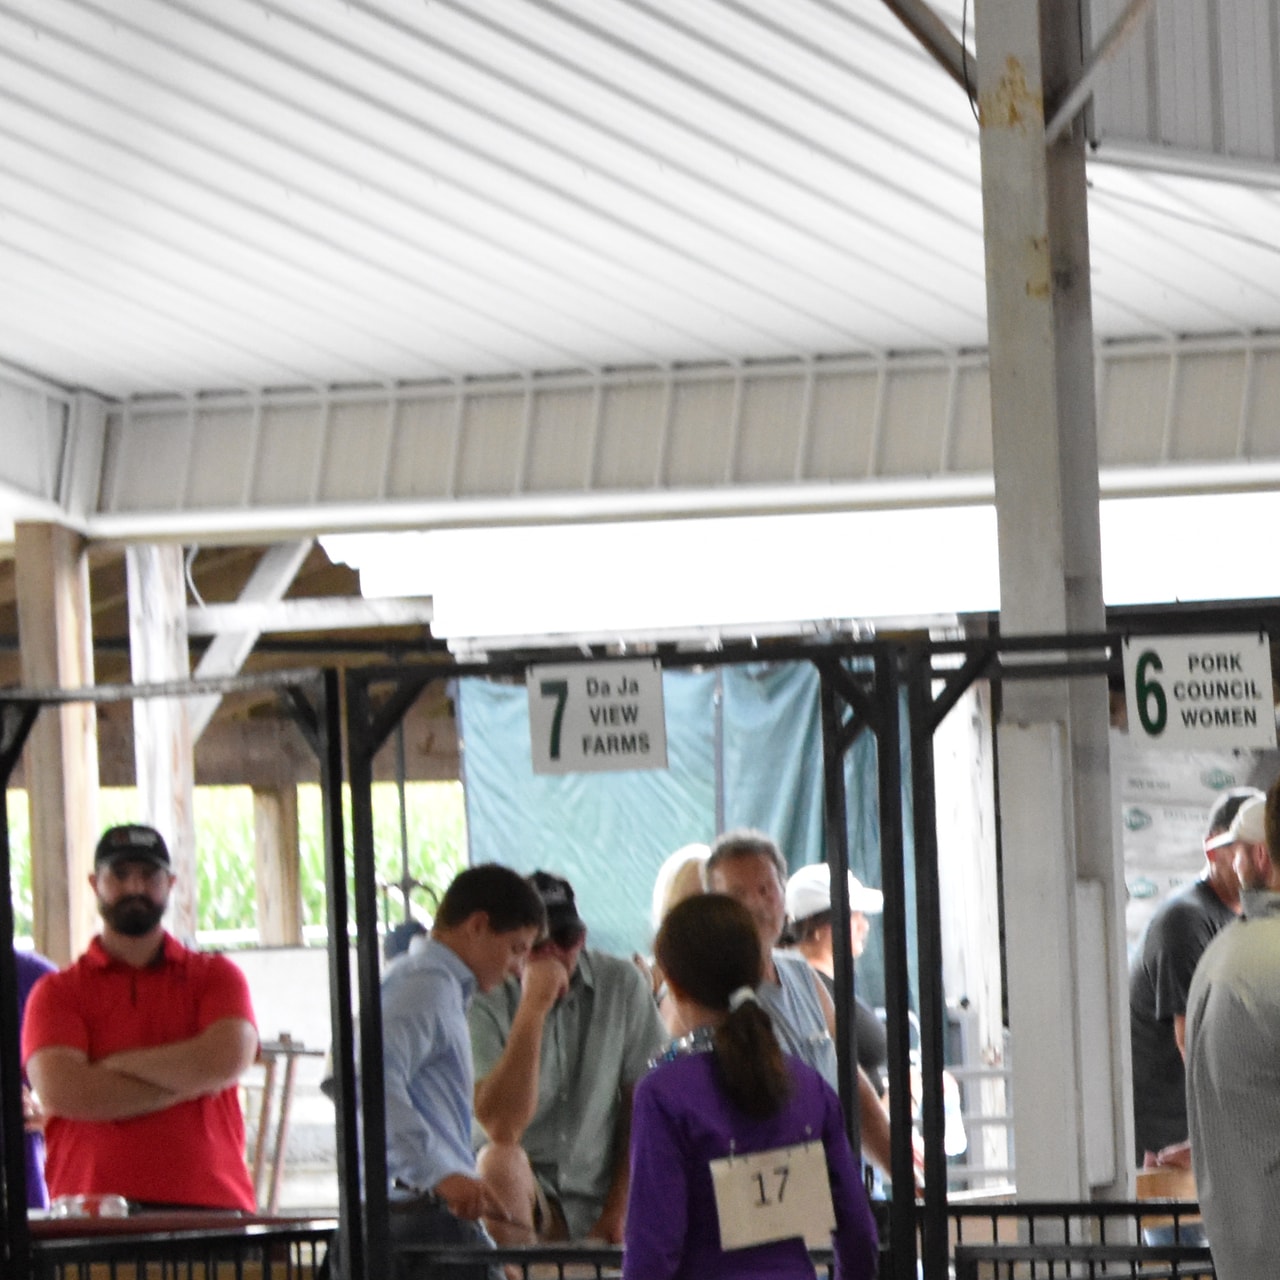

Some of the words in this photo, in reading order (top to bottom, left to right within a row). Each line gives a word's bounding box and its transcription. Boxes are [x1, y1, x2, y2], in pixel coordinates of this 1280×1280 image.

[1188, 653, 1243, 674] PORK
[1135, 648, 1168, 737] 6
[1173, 678, 1262, 702] COUNCIL
[540, 679, 568, 760] 7
[589, 704, 639, 726] VIEW
[1181, 705, 1257, 729] WOMEN
[582, 732, 651, 756] FARMS
[751, 1166, 789, 1208] 17
